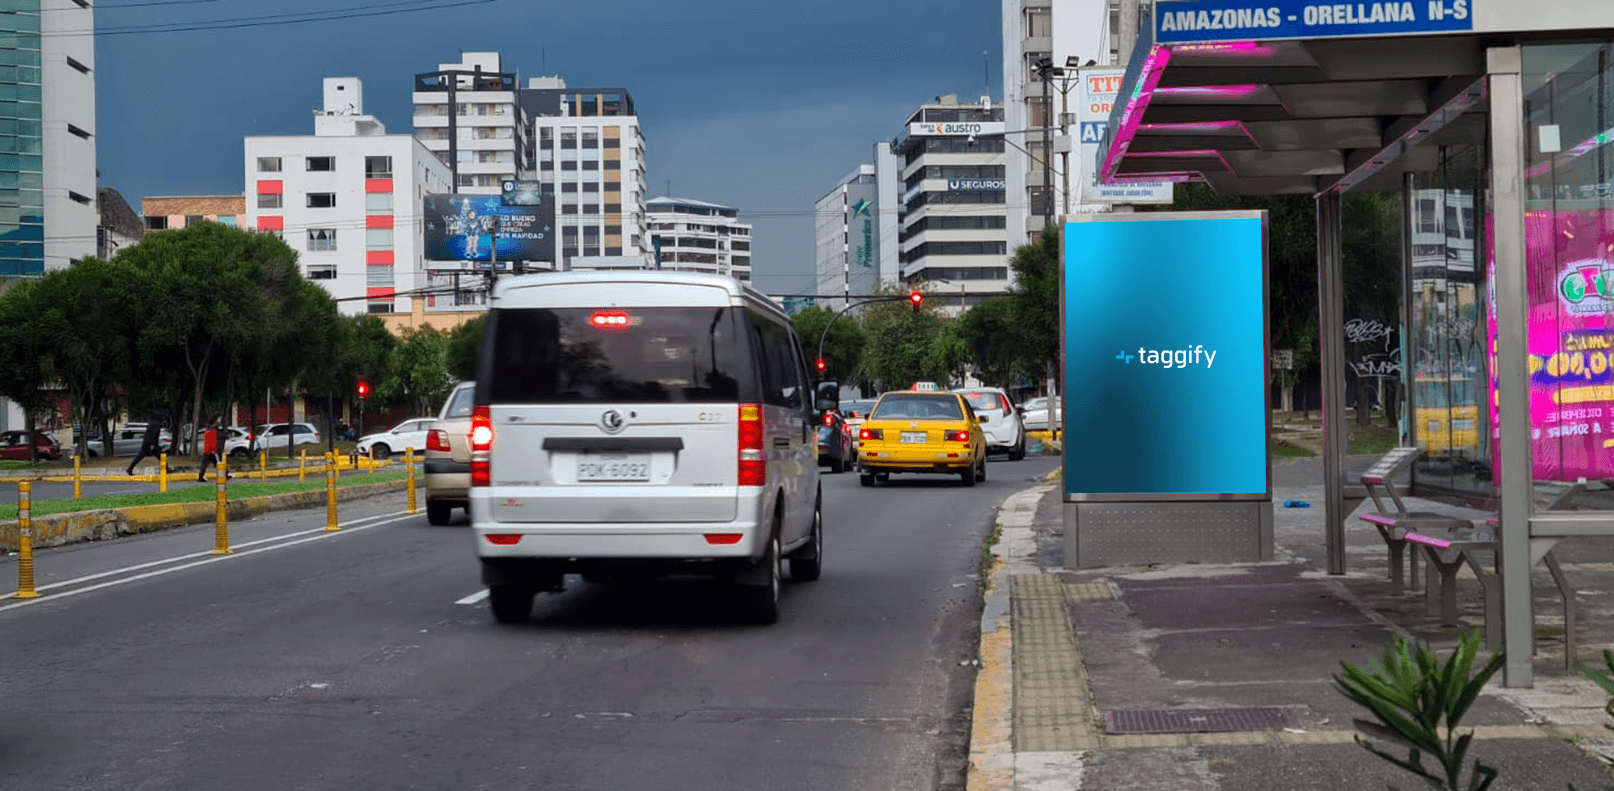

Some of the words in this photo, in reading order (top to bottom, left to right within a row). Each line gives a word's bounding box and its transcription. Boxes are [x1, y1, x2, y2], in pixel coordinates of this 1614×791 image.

[1161, 7, 1281, 32] AMAZONAS
[1303, 2, 1416, 26] ORELLANA
[1428, 0, 1468, 20] N-S
[945, 123, 981, 133] austro
[961, 181, 1006, 189] SEGUROS
[1138, 345, 1217, 368] taggify
